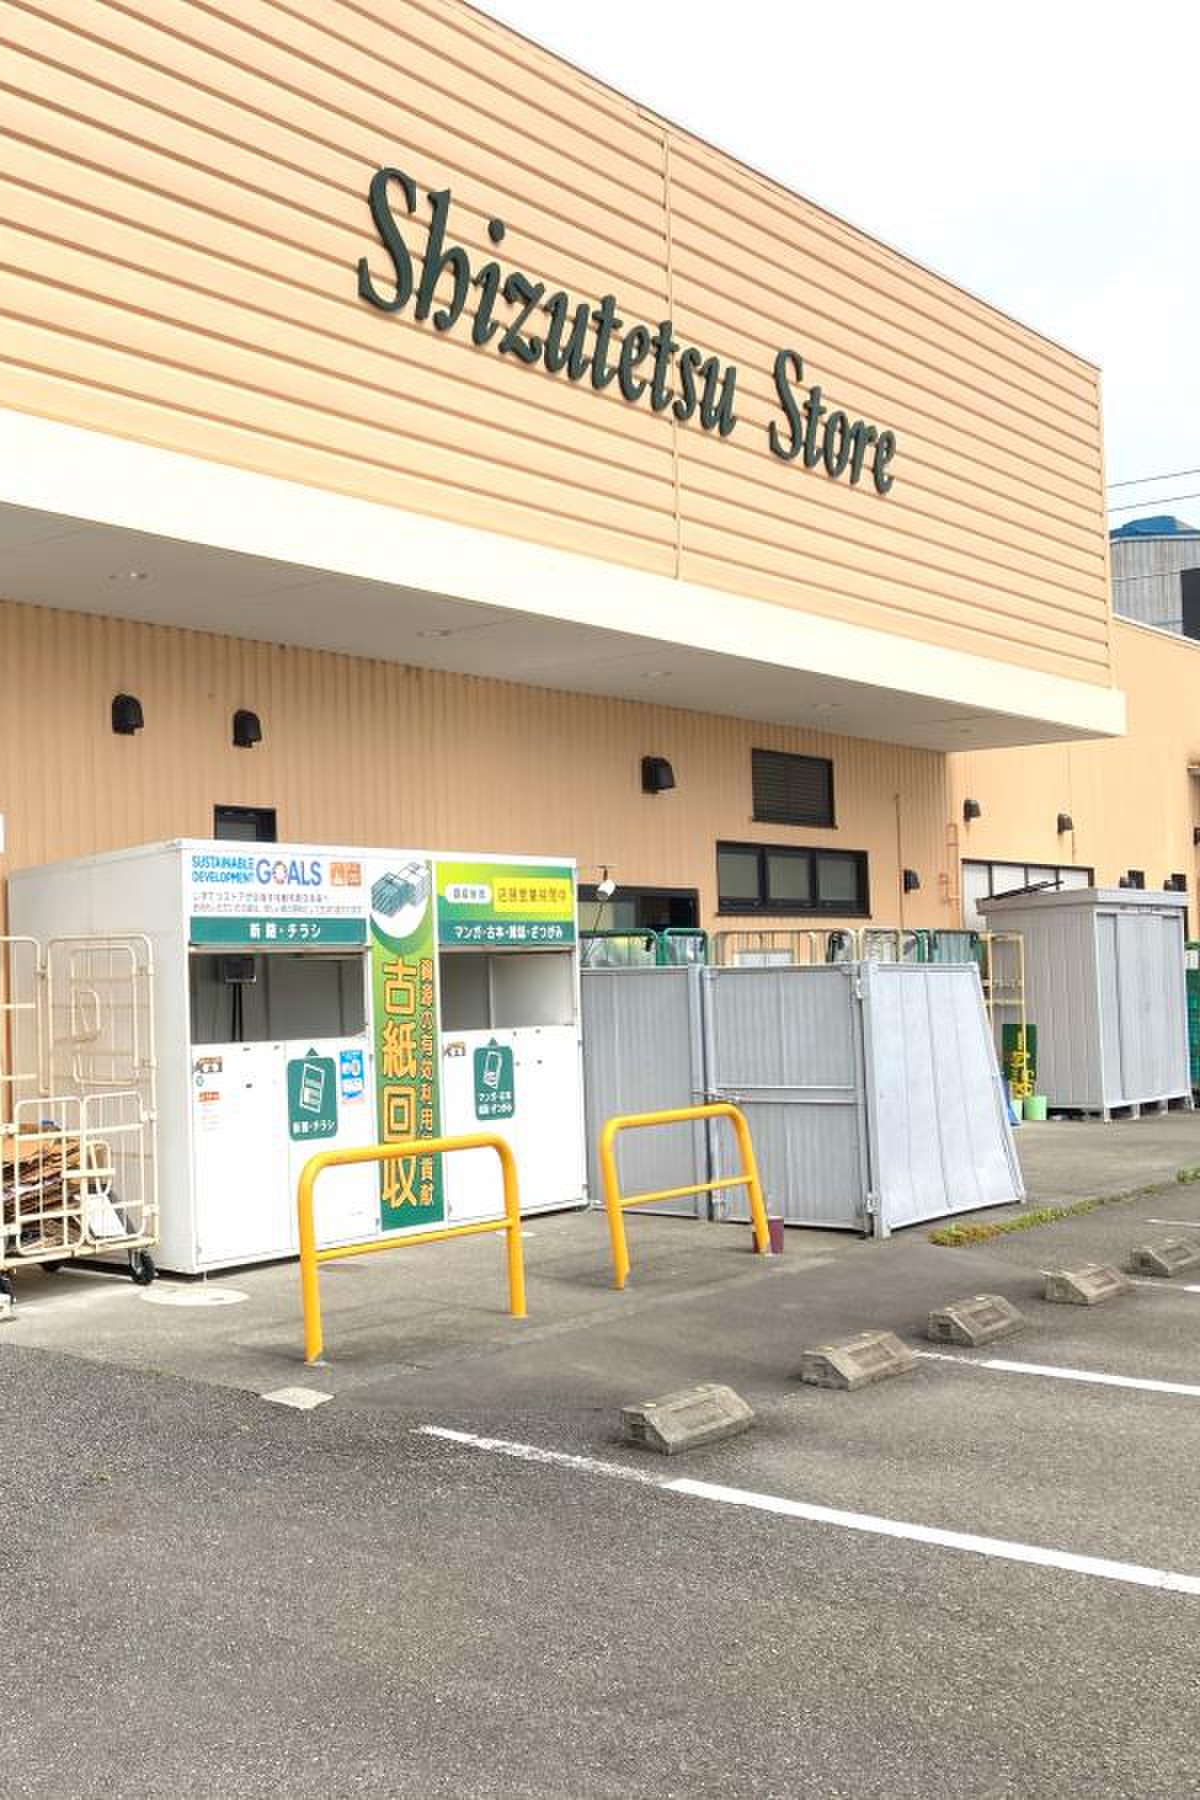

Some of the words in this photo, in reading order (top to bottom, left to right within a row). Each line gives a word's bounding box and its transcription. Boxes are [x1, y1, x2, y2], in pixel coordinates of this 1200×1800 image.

[357, 167, 737, 437] Shizutetsu
[767, 348, 897, 494] Store
[191, 855, 255, 870] SUSTAINABLE
[191, 870, 255, 885] DEVELOPMENT
[255, 858, 323, 887] GOALS
[382, 956, 418, 1210] 古紙回収
